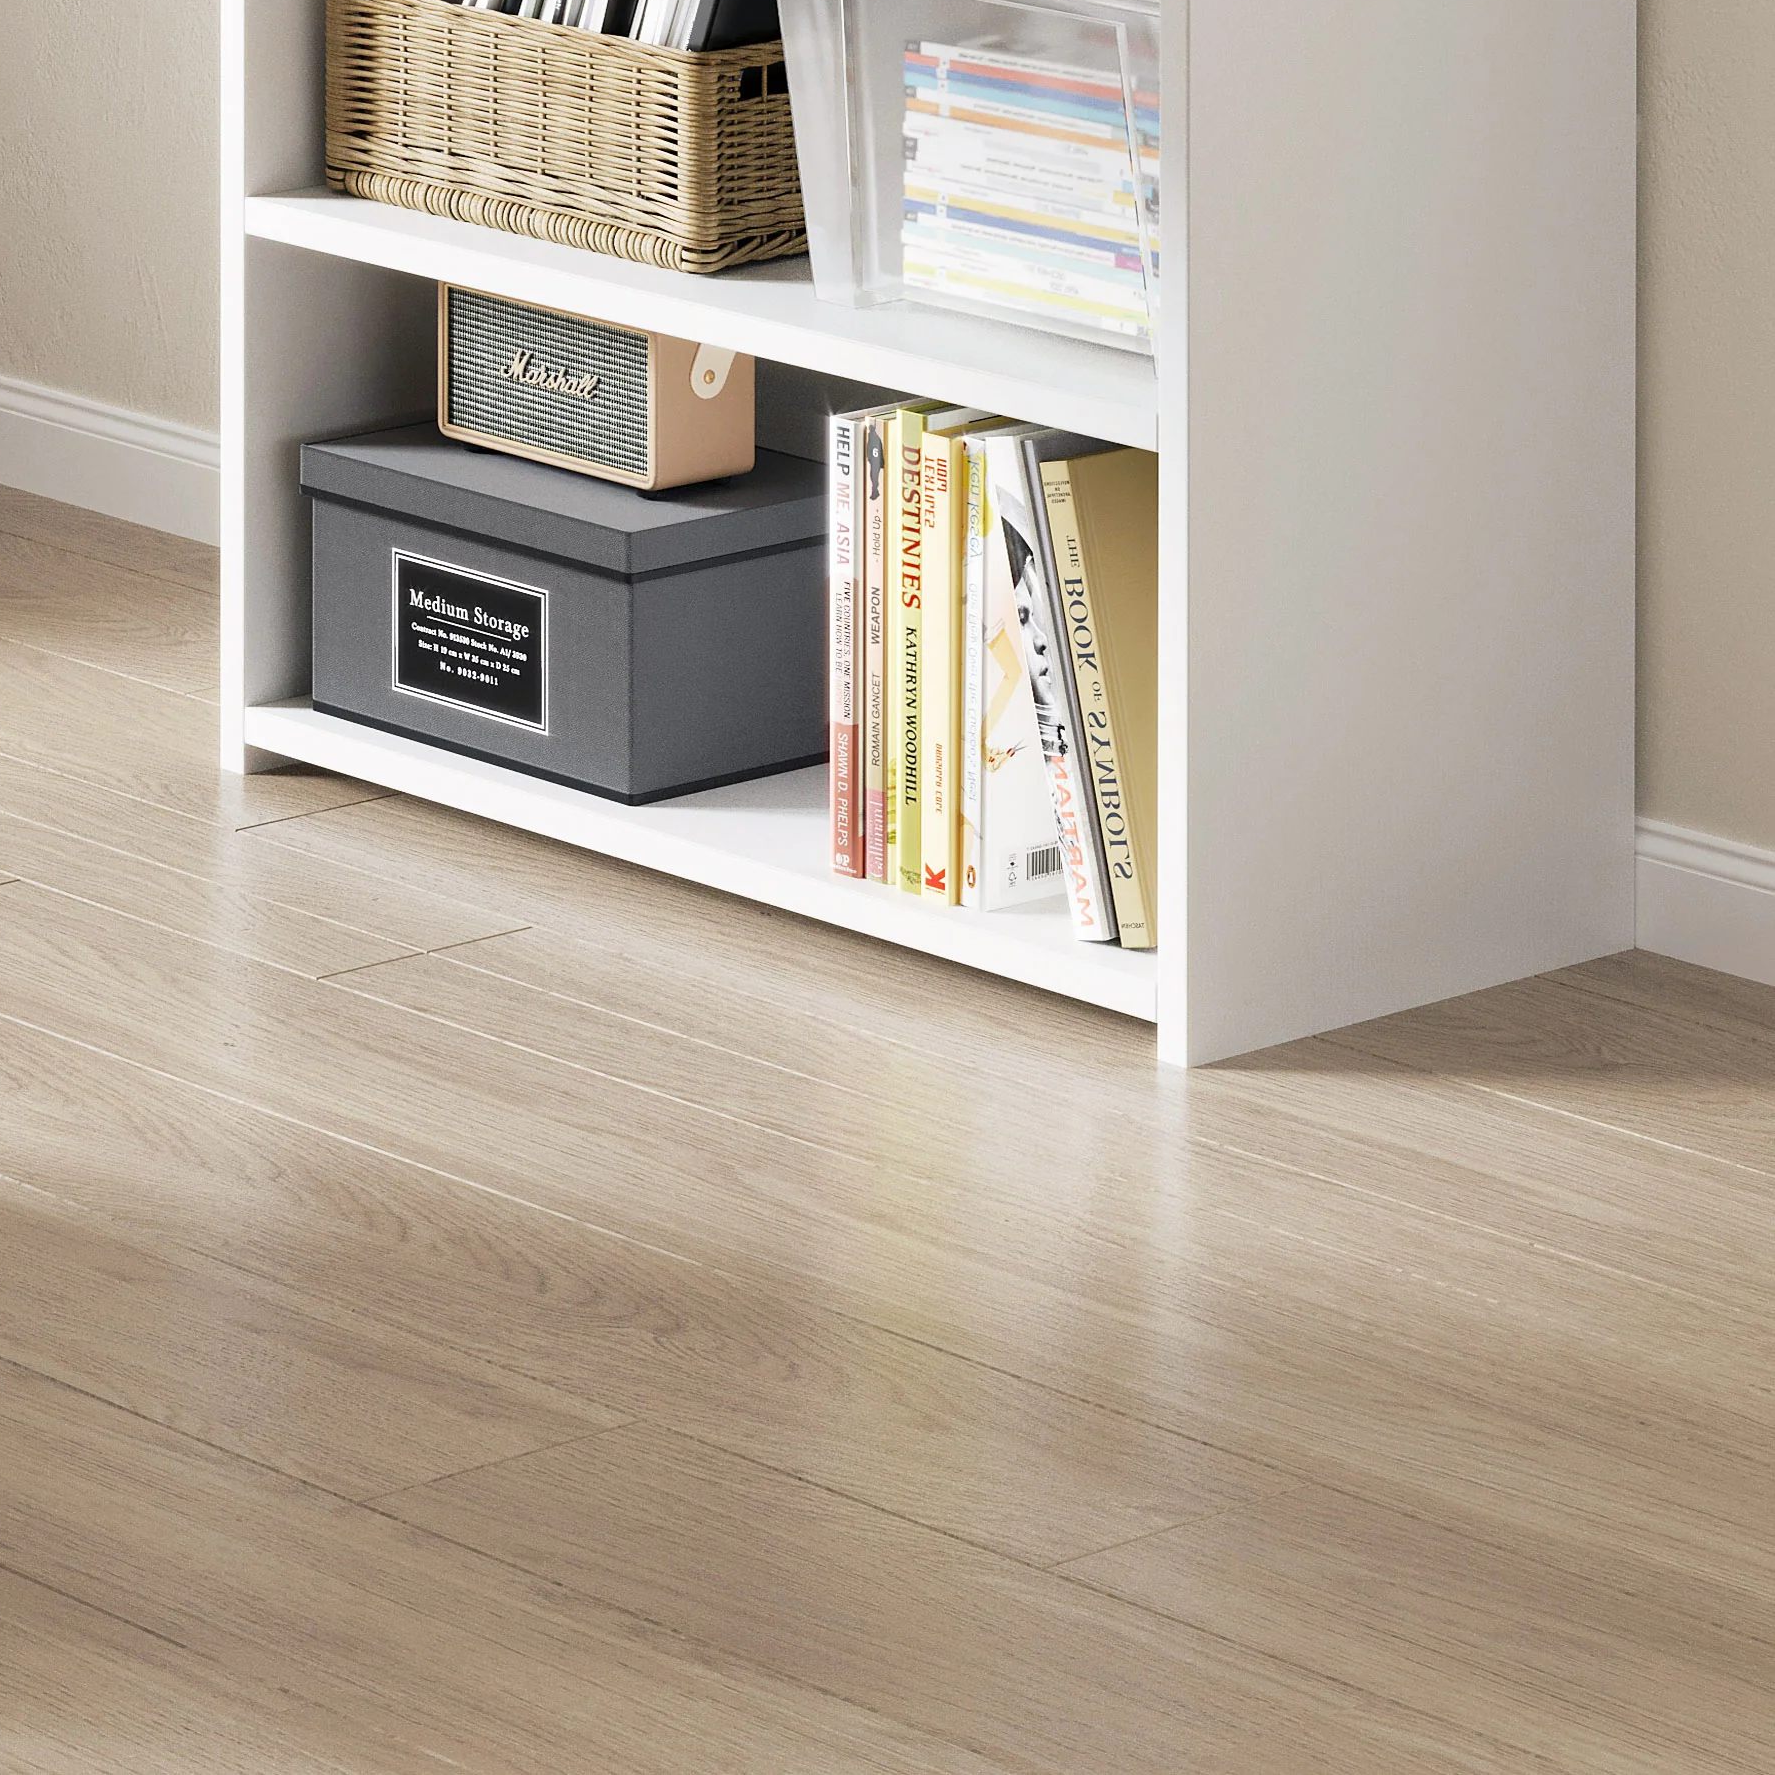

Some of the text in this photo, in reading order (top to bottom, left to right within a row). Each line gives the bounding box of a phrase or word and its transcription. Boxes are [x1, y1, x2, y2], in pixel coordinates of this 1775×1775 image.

[500, 349, 599, 400] Marshall
[835, 425, 851, 476] HELP
[871, 448, 878, 457] 6
[835, 522, 851, 566] ASIA
[409, 589, 529, 641] Medium Storage
[870, 515, 881, 766] ROMAIN GANCET WEAPON Hold Up
[902, 444, 921, 806] DESTINIES KATHRYN WOODHILL
[440, 661, 455, 674] No.
[842, 581, 852, 719] FIVE COUNTRIES, ONE MISSION
[836, 733, 850, 846] SHAWN D. PHELPS
